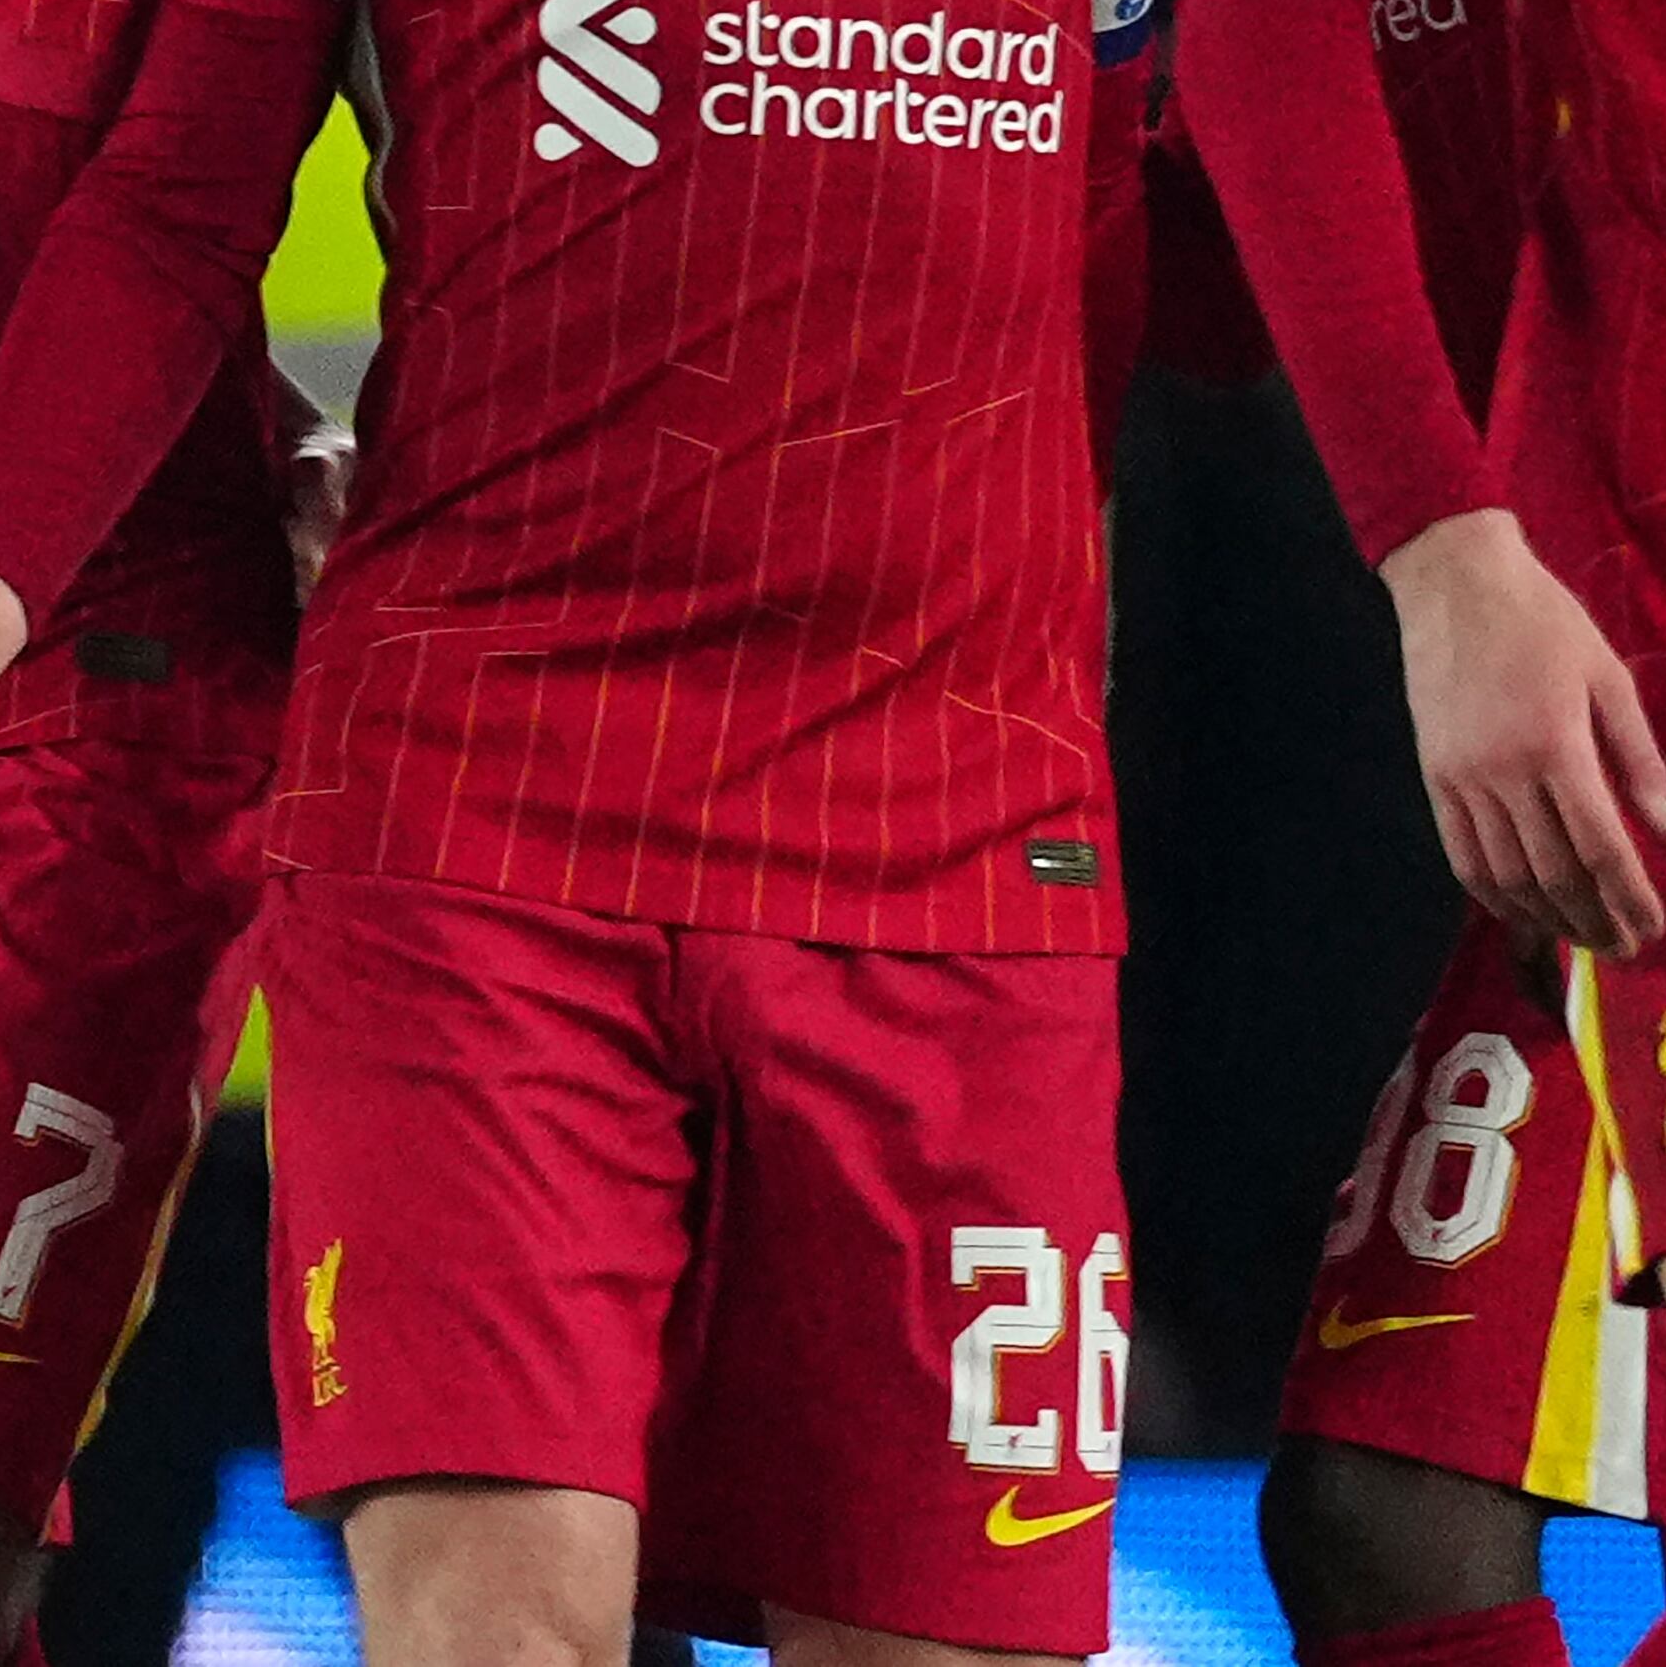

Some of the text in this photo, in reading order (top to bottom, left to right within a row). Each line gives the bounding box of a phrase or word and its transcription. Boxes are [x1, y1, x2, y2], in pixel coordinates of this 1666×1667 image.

[704, 0, 1058, 86] standard
[700, 72, 1064, 154] chartered
[948, 1225, 1131, 1479] 26
